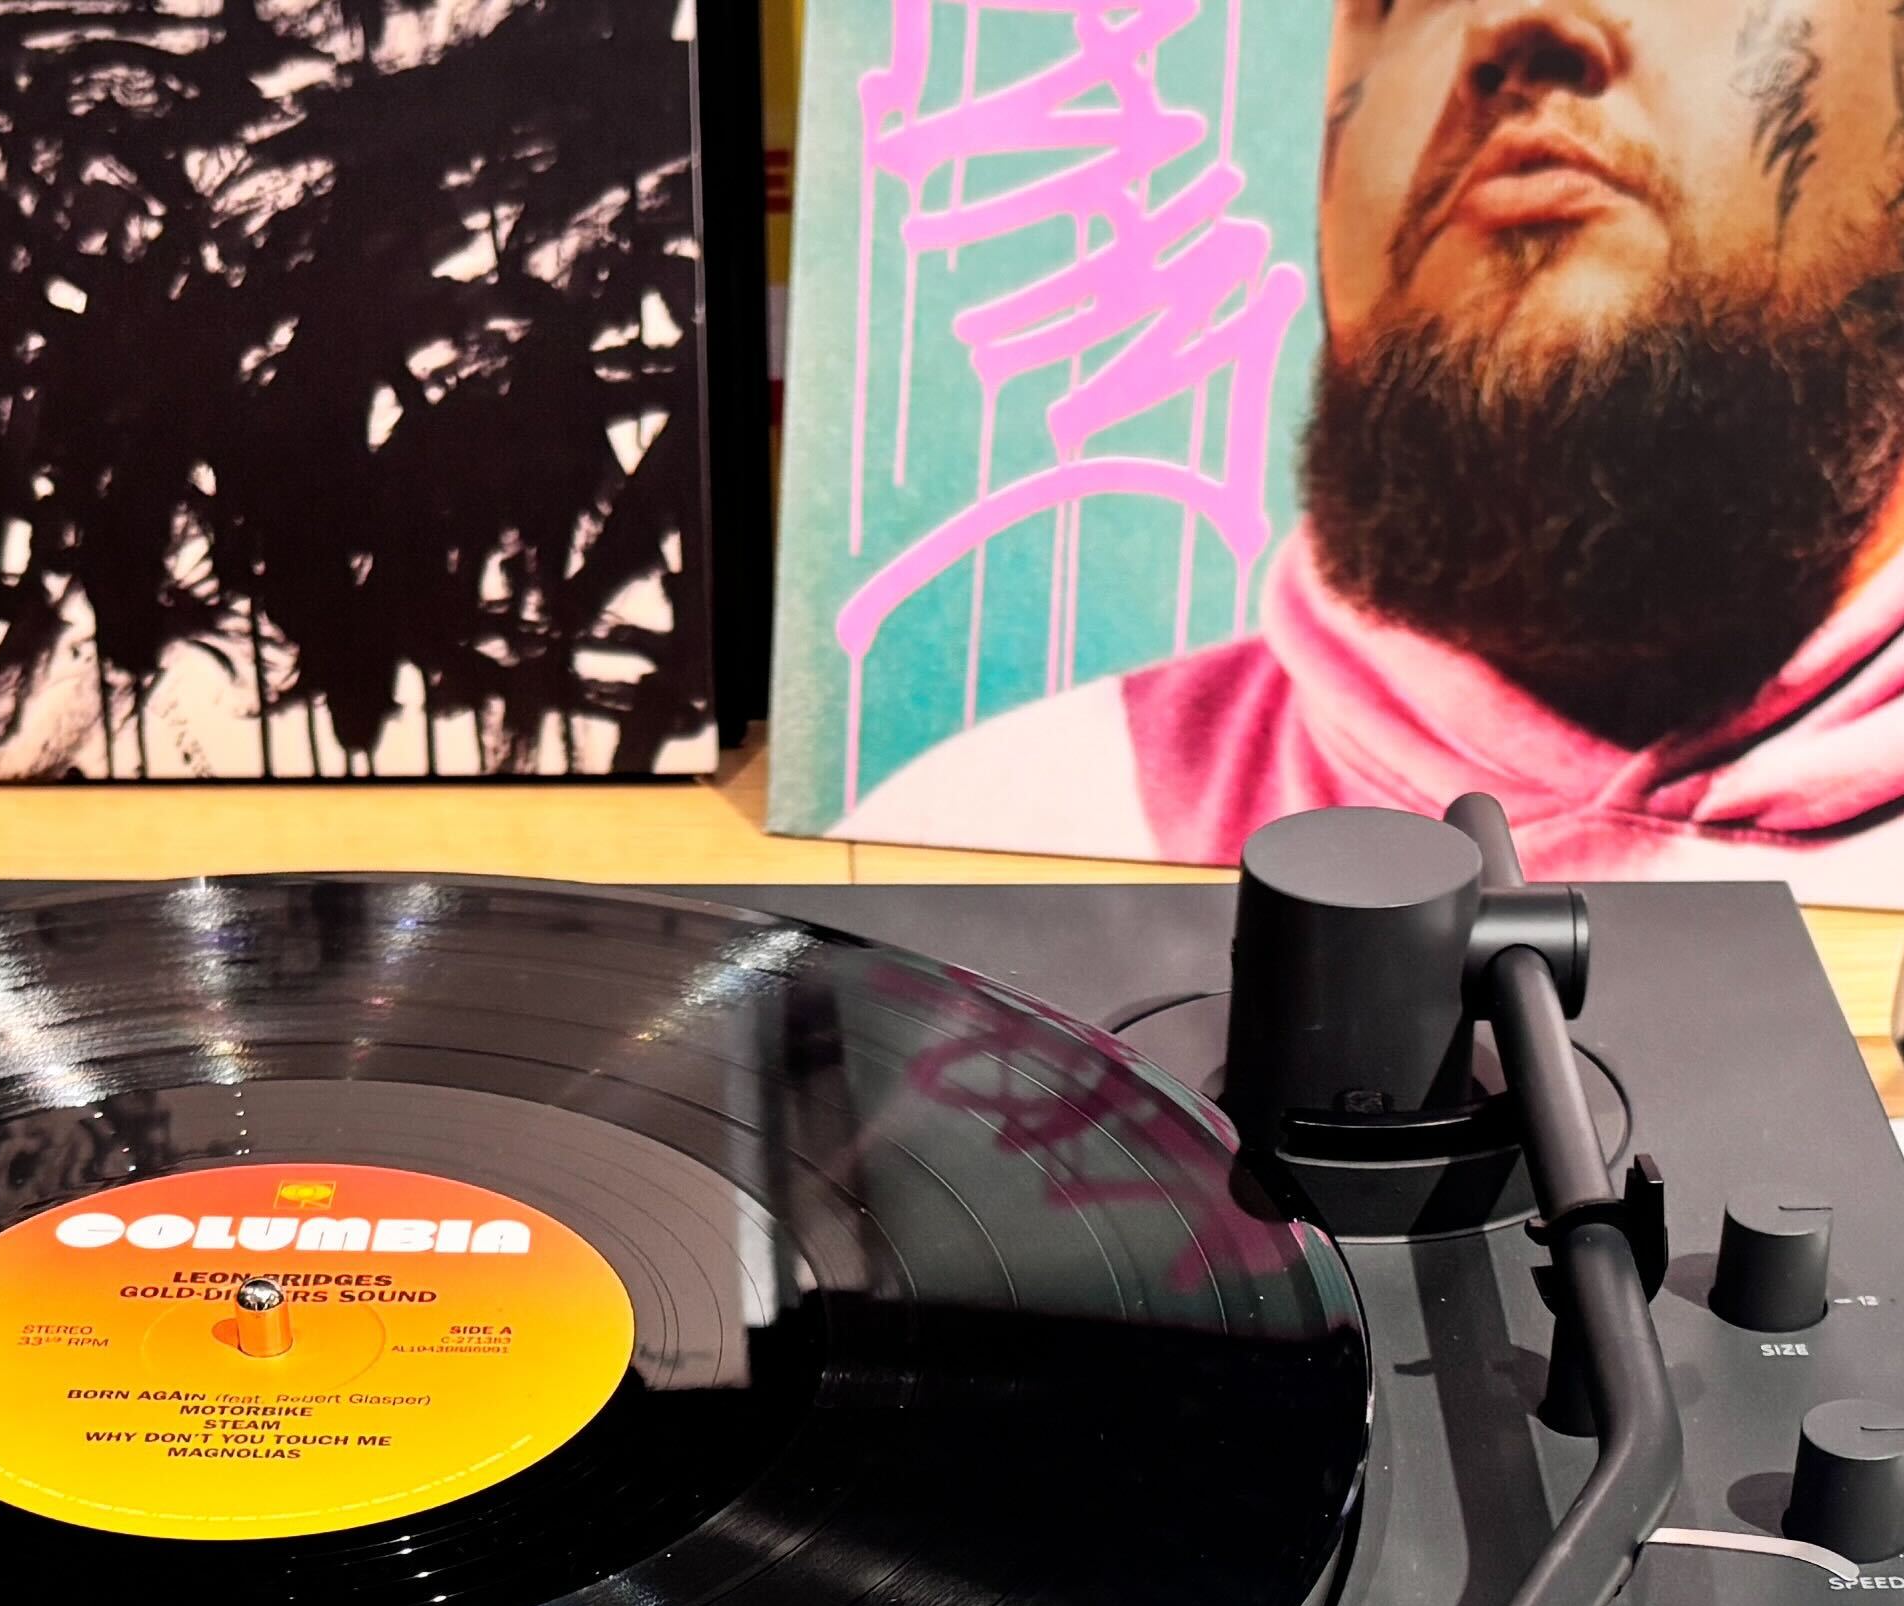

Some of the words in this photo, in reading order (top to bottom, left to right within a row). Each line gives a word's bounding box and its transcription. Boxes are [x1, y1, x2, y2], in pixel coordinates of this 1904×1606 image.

[55, 1212, 531, 1254] COLUMBIA
[173, 1271, 252, 1284] LEON
[119, 1285, 328, 1304] GOLD-DIRS
[339, 1289, 437, 1304] SOUND
[1856, 1295, 1880, 1307] 12
[22, 1324, 93, 1336] STEREO
[449, 1325, 494, 1336] SIDE
[499, 1325, 513, 1336] A
[67, 1336, 110, 1348] RPM
[1760, 1343, 1809, 1357] SIZE
[67, 1389, 130, 1400] BORN
[137, 1390, 206, 1401] AGAIN
[179, 1405, 314, 1417] MOTORBIKE
[203, 1419, 281, 1431] STEAM
[85, 1431, 138, 1442] WHY
[144, 1432, 214, 1444] DON'T
[222, 1433, 265, 1445] YOU
[274, 1434, 349, 1445] TOUCH
[357, 1435, 393, 1447] ME
[167, 1447, 302, 1459] MAGNOLIAS
